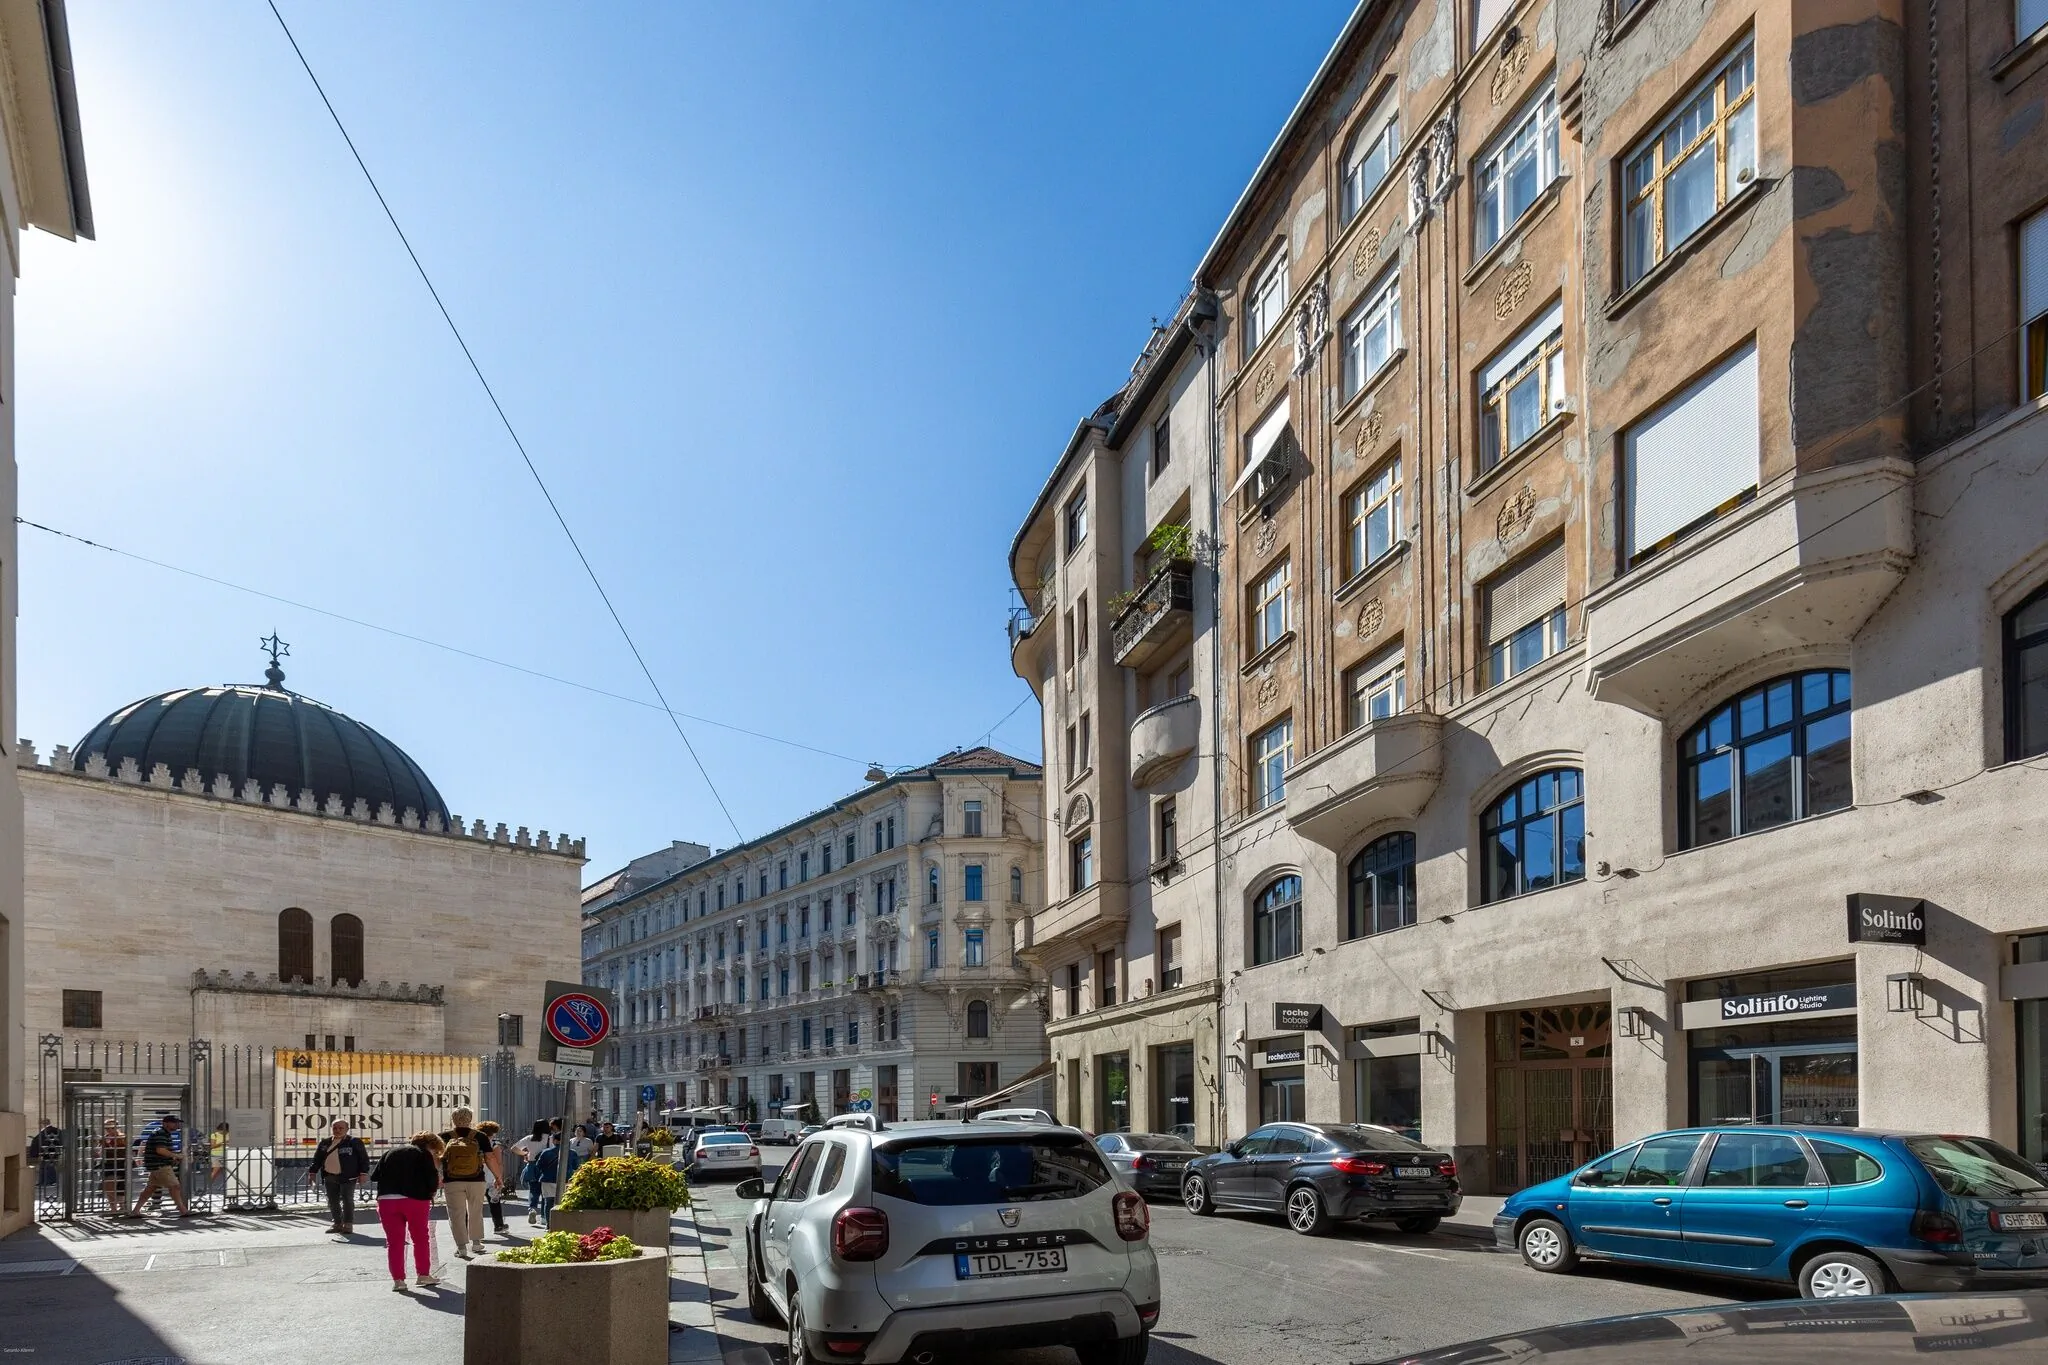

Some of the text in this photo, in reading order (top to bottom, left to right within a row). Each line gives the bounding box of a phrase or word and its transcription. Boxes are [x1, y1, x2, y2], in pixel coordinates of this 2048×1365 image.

[1862, 907, 1923, 931] Solinfo
[1799, 995, 1828, 1004] Lighting
[1724, 994, 1799, 1017] Solinfo
[1799, 1002, 1823, 1010] Studio
[1282, 1009, 1309, 1017] roche
[1282, 1016, 1309, 1025] bobois
[1267, 1051, 1300, 1061] rochebobois
[566, 1068, 573, 1077] 2
[284, 1082, 318, 1090] EVERY
[347, 1083, 389, 1091] DURING
[437, 1084, 471, 1092] HOURS
[285, 1091, 471, 1109] FREE GUIDED
[2004, 1213, 2045, 1227] SHF-982
[955, 1235, 1067, 1250] DUSTER
[972, 1251, 1061, 1272] TDL-753
